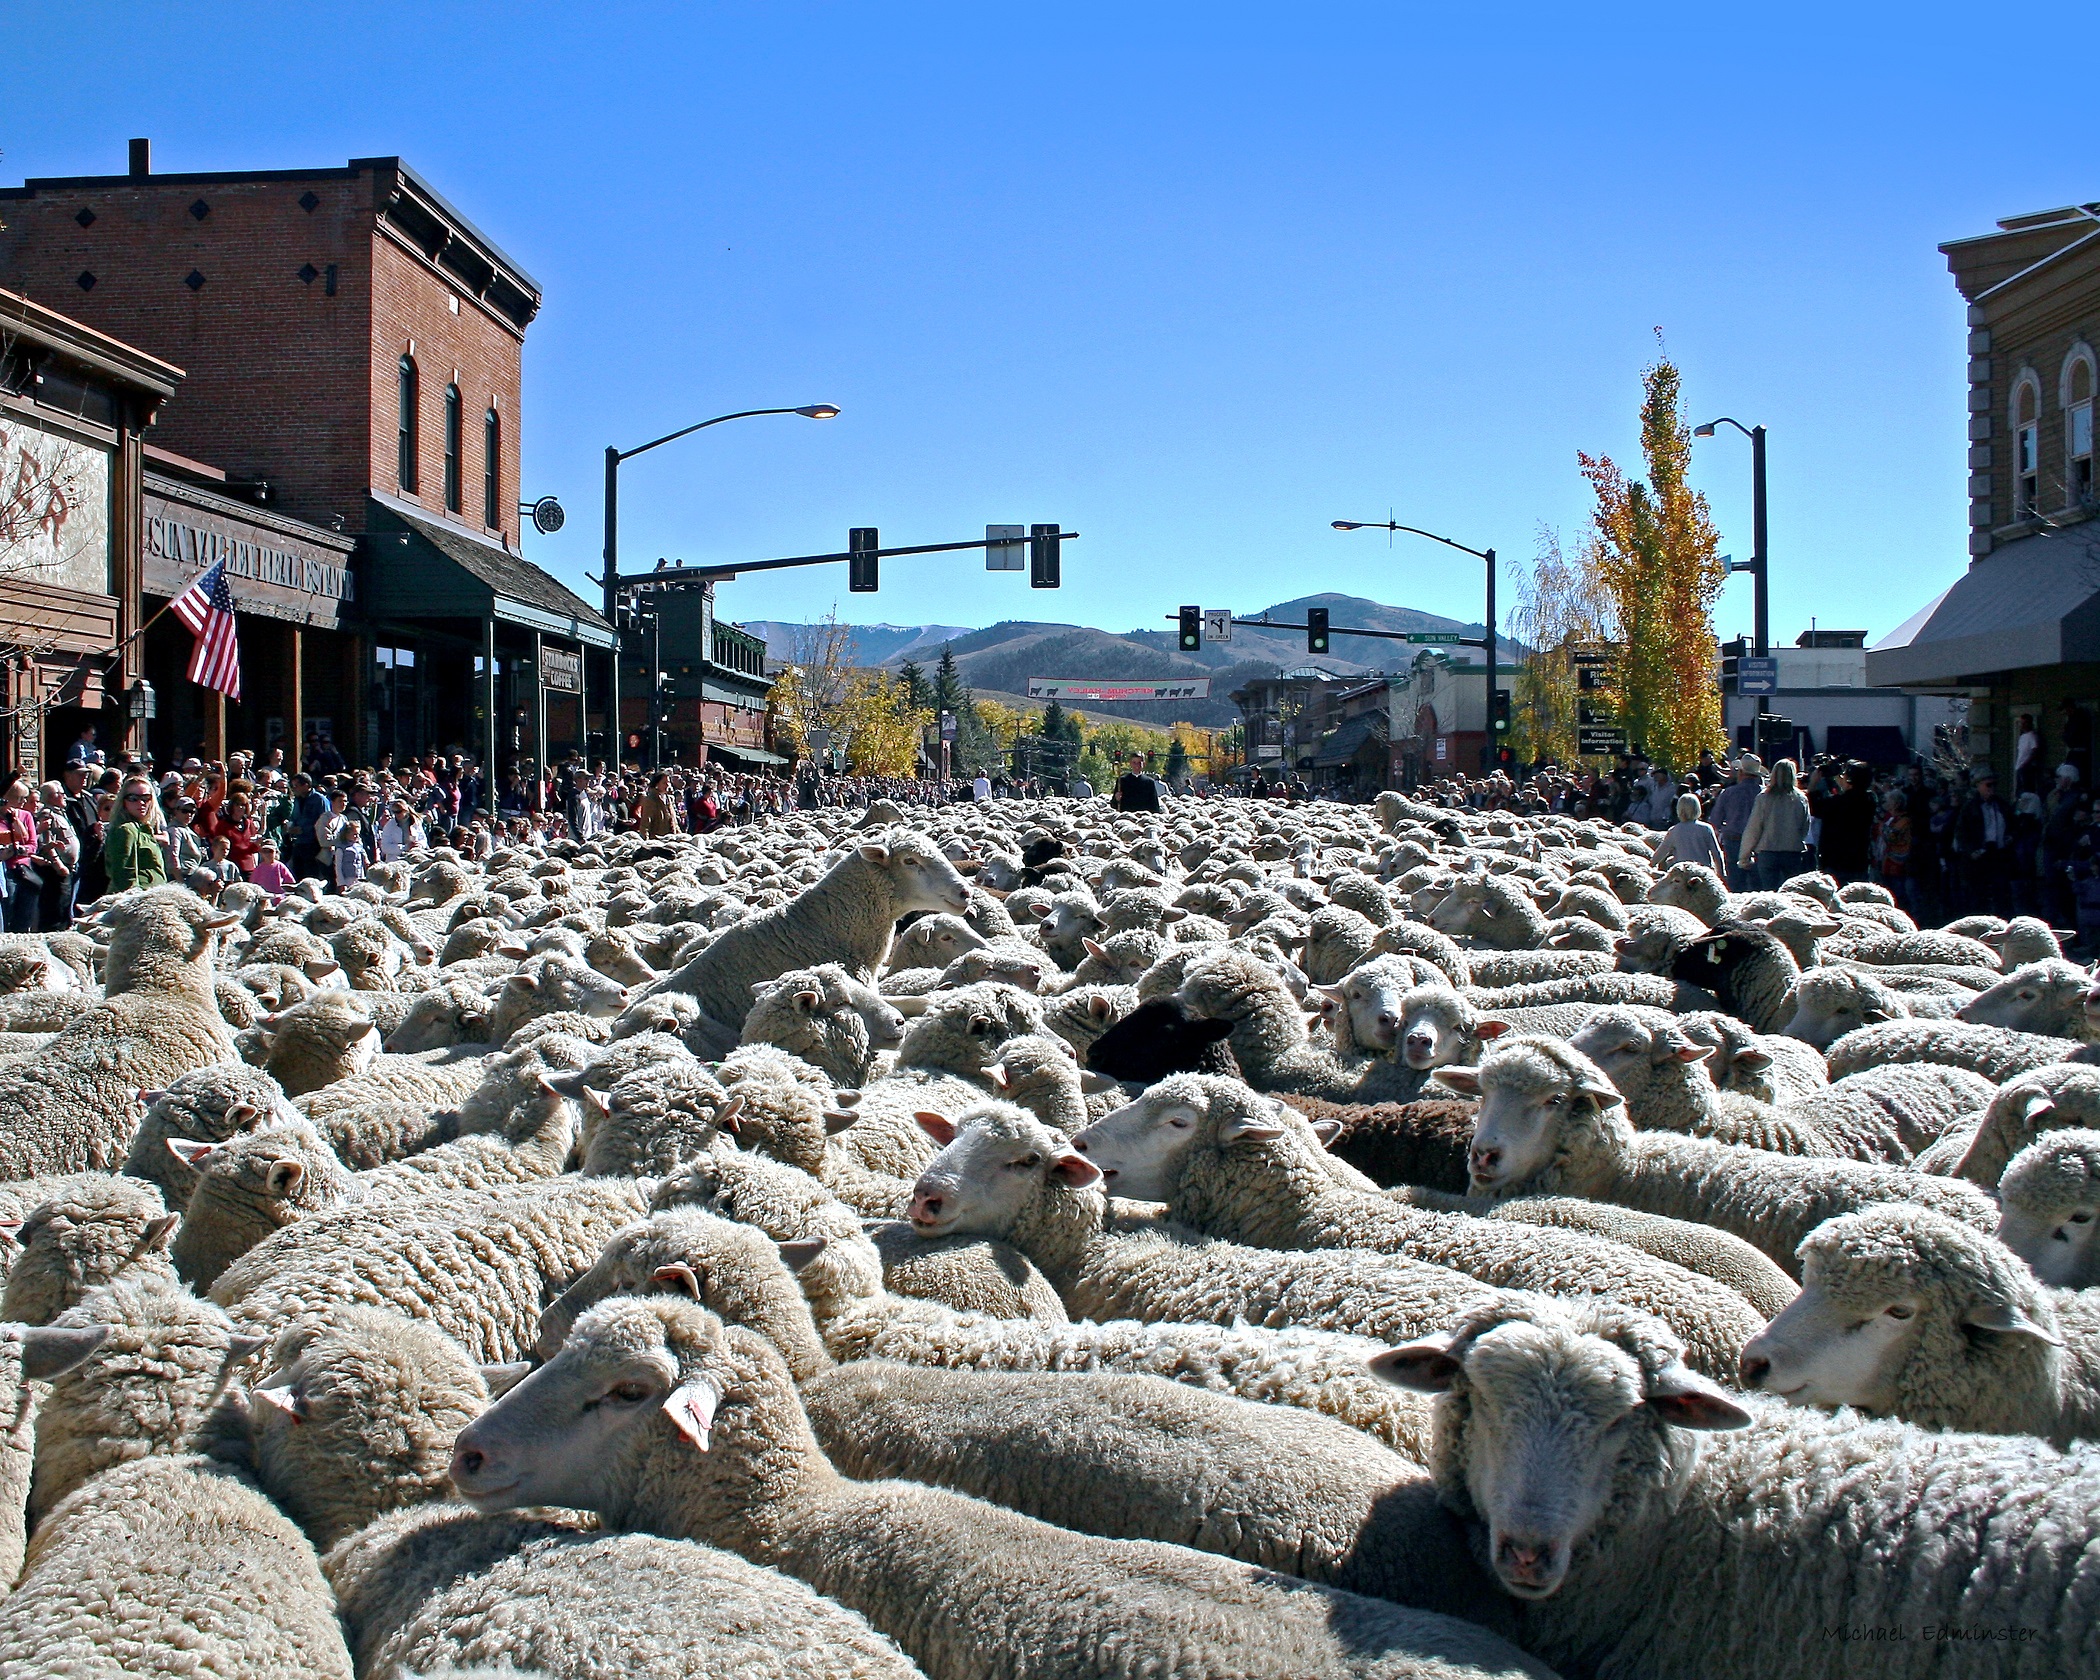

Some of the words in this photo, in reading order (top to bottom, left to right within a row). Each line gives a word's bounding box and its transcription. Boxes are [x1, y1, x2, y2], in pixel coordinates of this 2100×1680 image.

[150, 515, 189, 562] SUN
[259, 546, 301, 590] REAL
[301, 557, 354, 602] ESTATE
[545, 651, 578, 673] STARBUCKS
[551, 670, 573, 689] COFFEE
